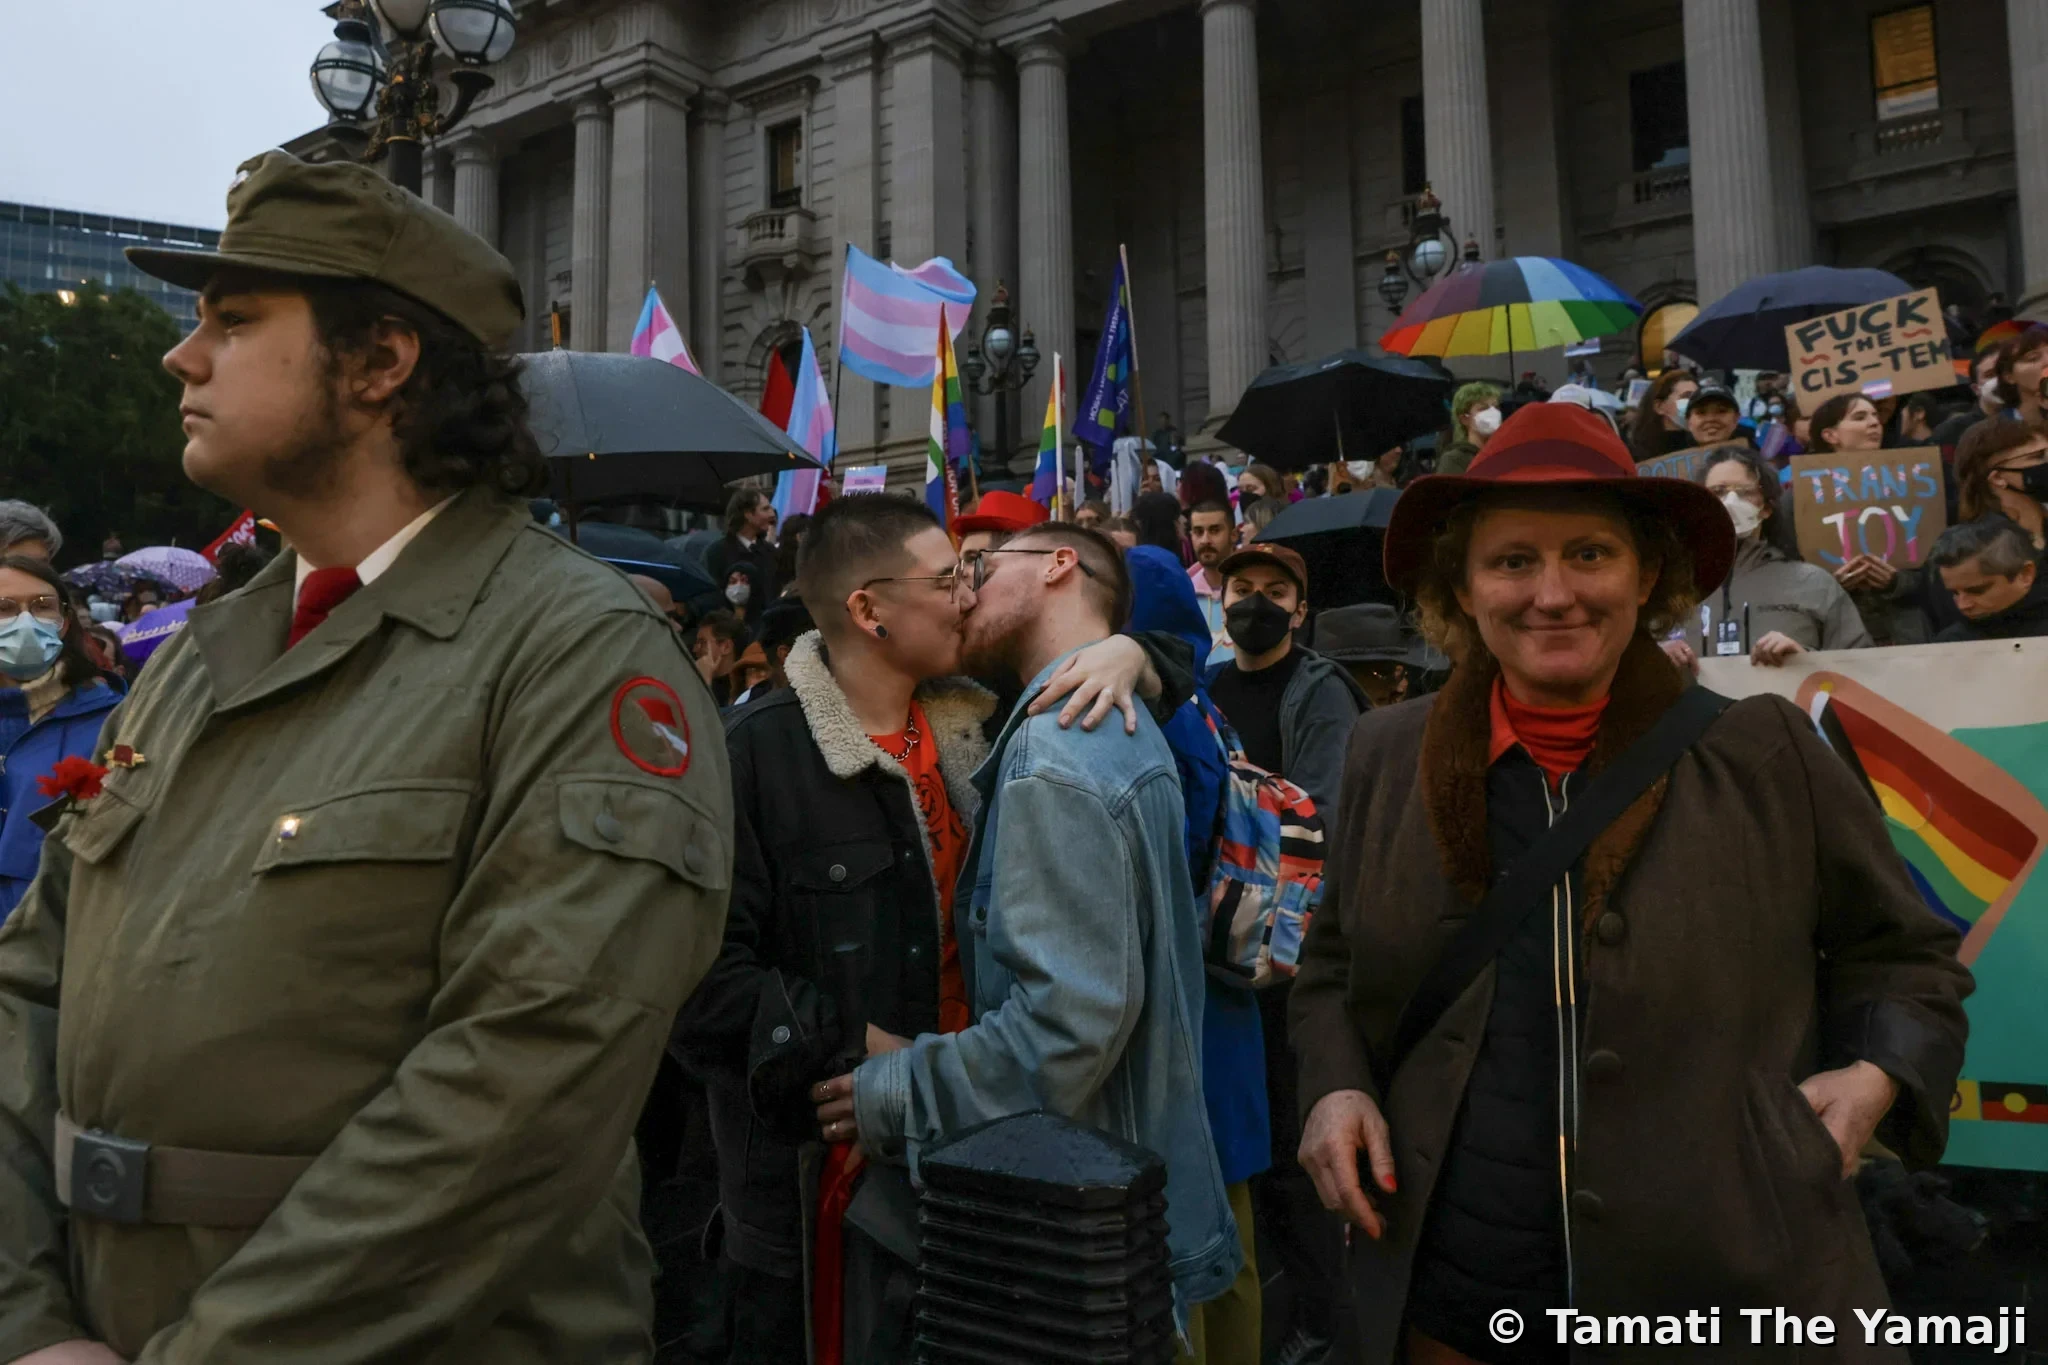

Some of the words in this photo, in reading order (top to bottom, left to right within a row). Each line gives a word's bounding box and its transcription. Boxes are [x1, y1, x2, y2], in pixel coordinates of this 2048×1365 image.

[1795, 297, 1929, 352] FUCK
[1833, 332, 1893, 356] THE
[1801, 338, 1950, 392] CIS-TEM
[1800, 462, 1937, 504] TRANS
[1818, 505, 1923, 564] JOY
